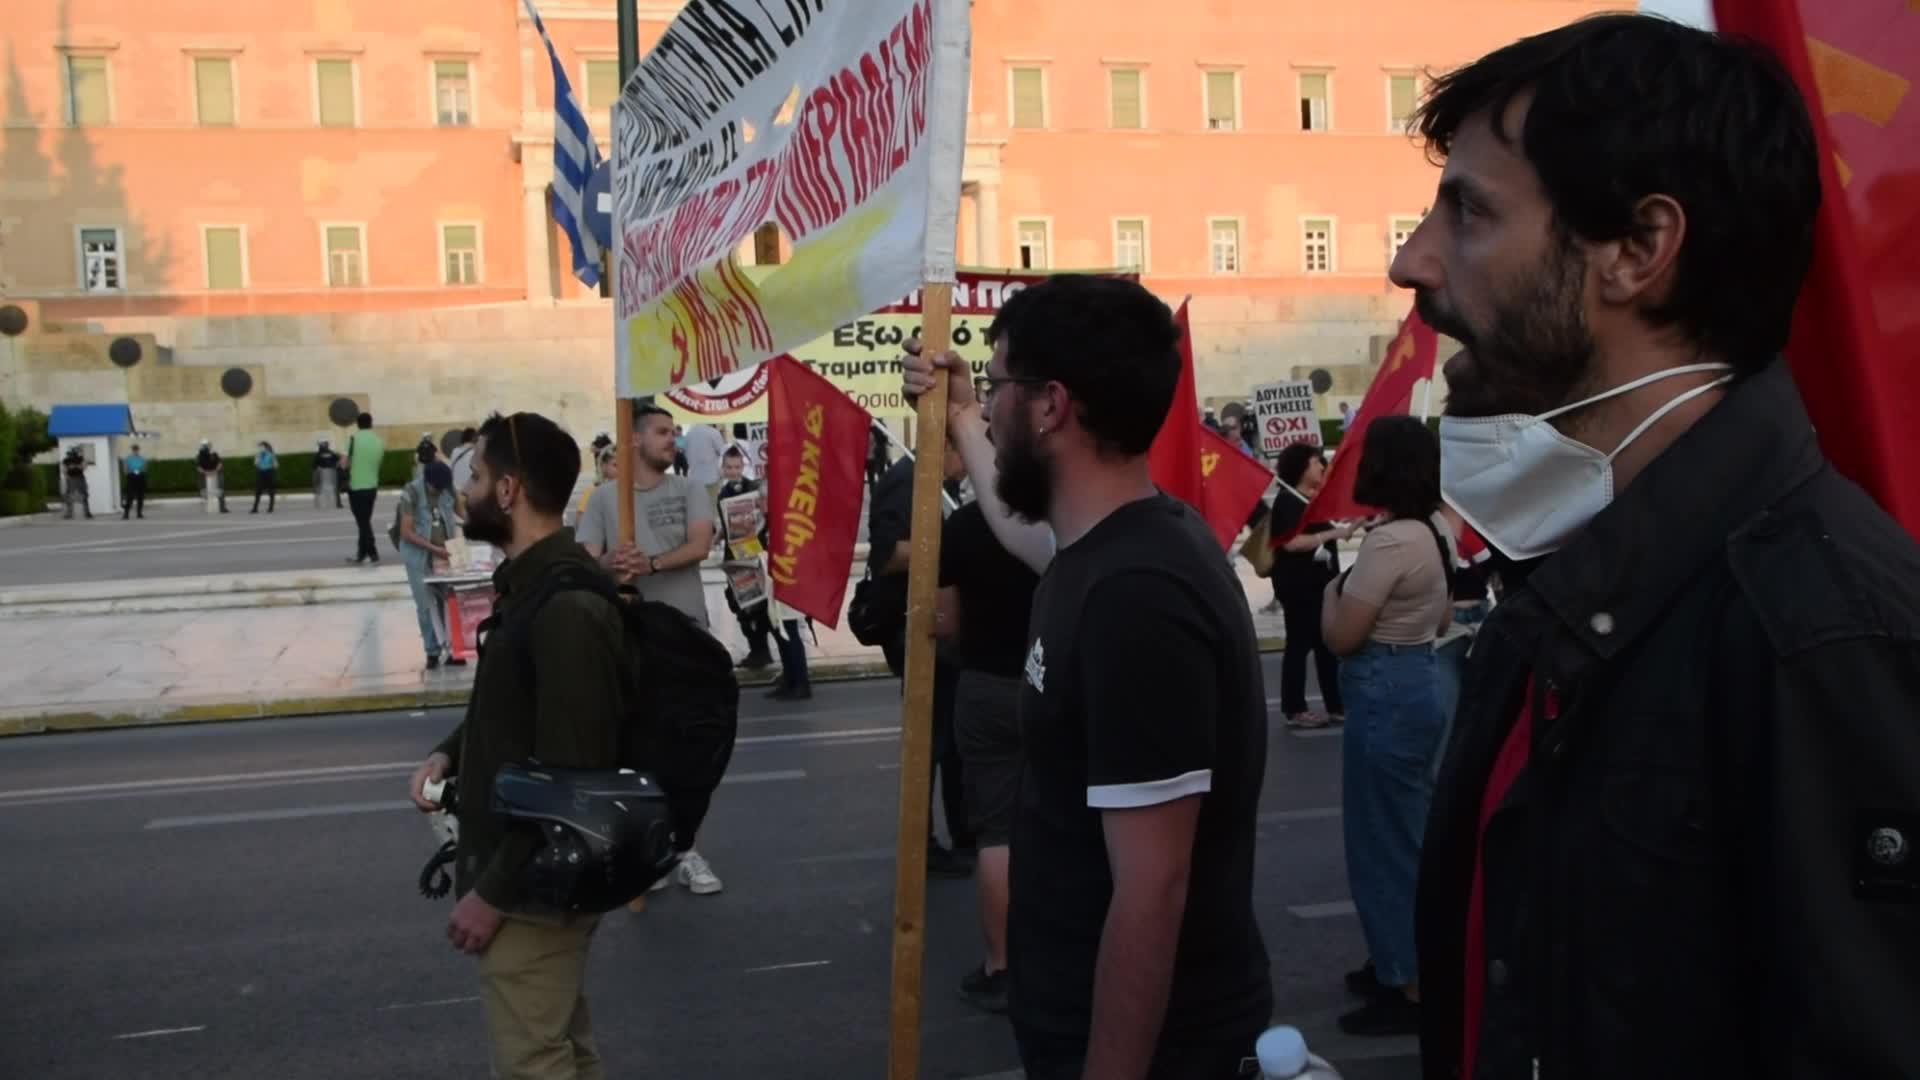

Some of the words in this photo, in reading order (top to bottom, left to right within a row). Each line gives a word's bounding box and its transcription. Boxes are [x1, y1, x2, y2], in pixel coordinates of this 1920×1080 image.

[1256, 385, 1311, 402] ΔΟΥΛΕΙΕΣ
[1258, 399, 1313, 416] ΑΥΞΗΣΕΙΣ
[1266, 416, 1308, 436] ΟΧΙ
